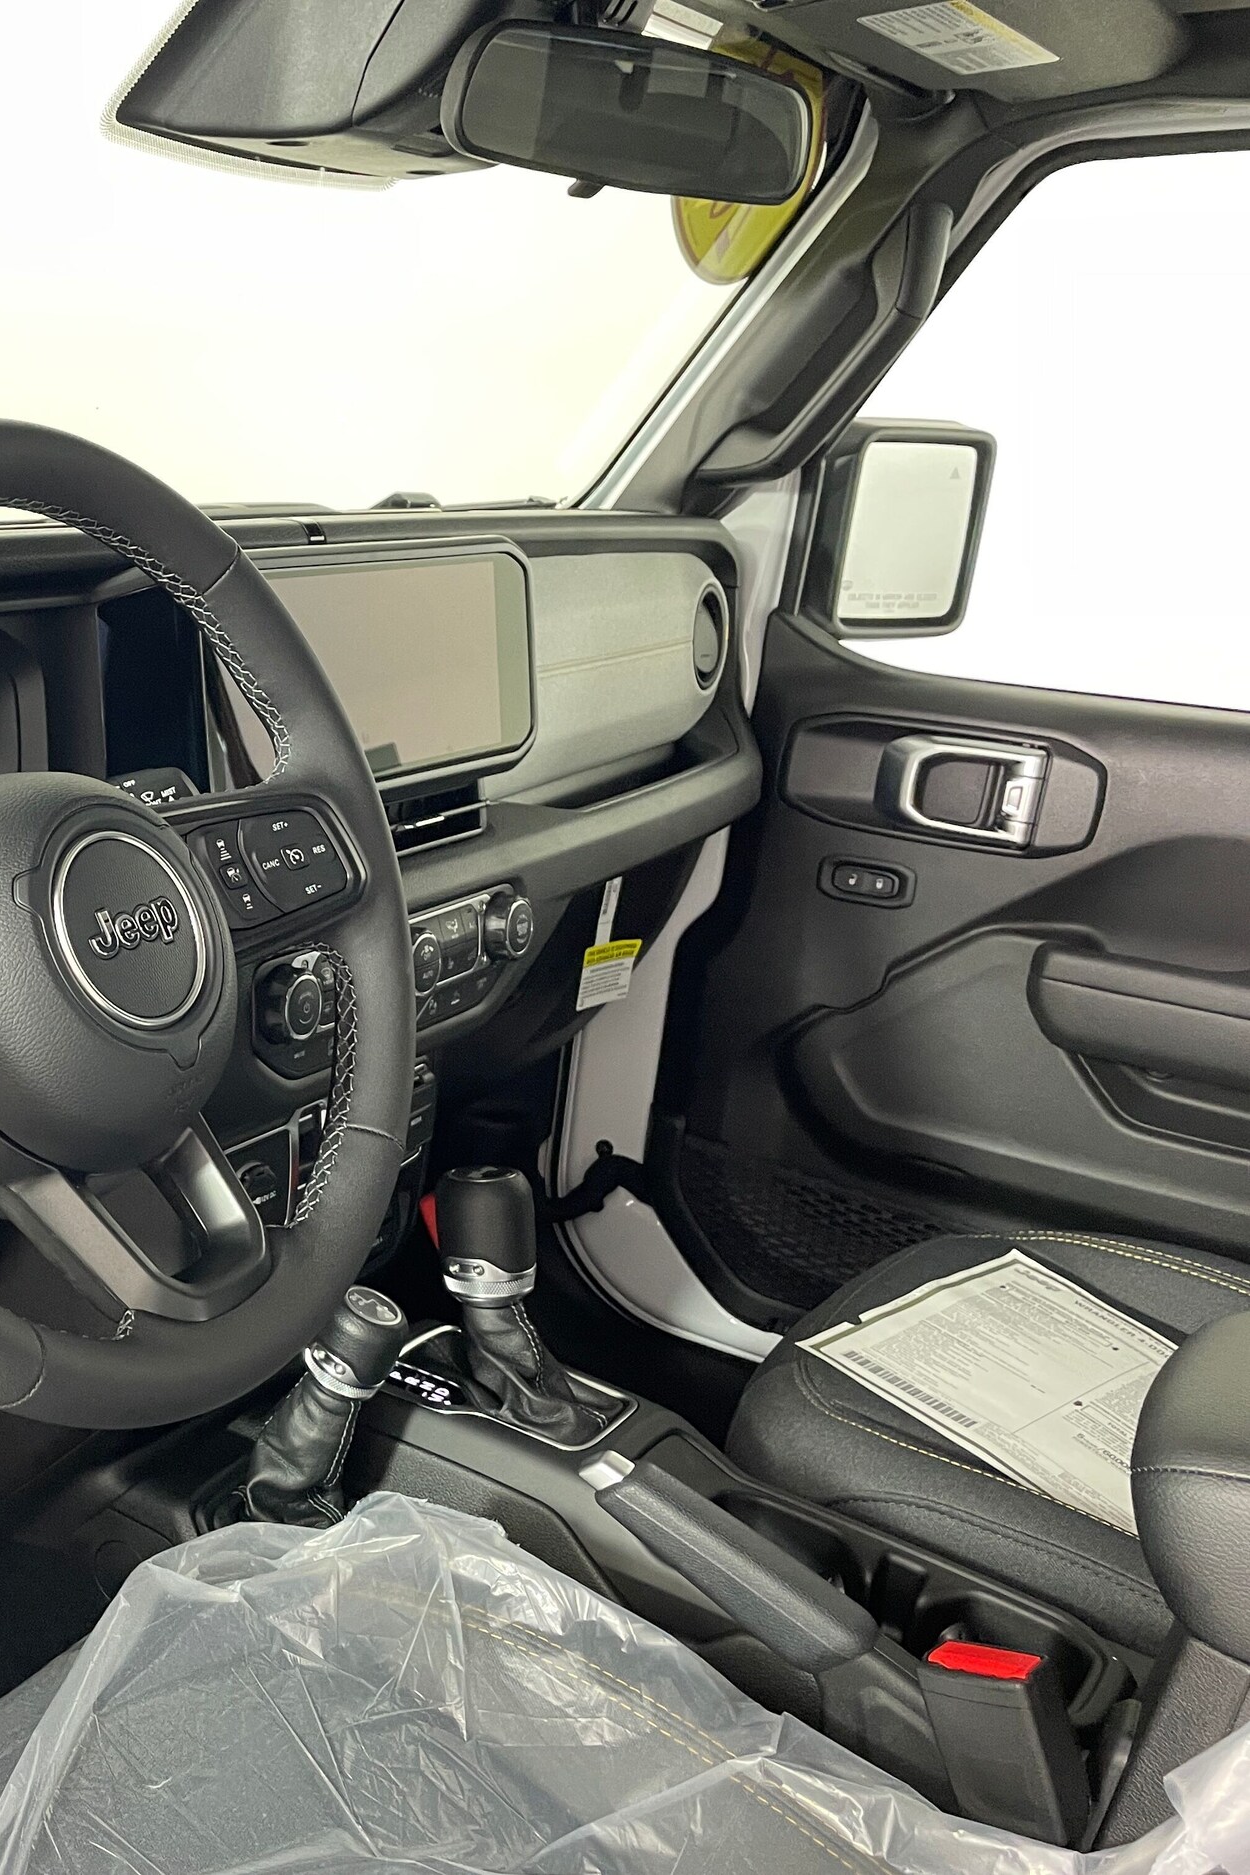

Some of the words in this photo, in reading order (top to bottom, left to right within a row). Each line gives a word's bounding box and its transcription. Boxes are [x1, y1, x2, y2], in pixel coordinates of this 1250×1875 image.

[272, 821, 288, 832] SET+
[312, 844, 326, 854] RES
[262, 858, 280, 870] CANC
[88, 896, 179, 960] Jeep
[1074, 1300, 1136, 1338] WRANGLER
